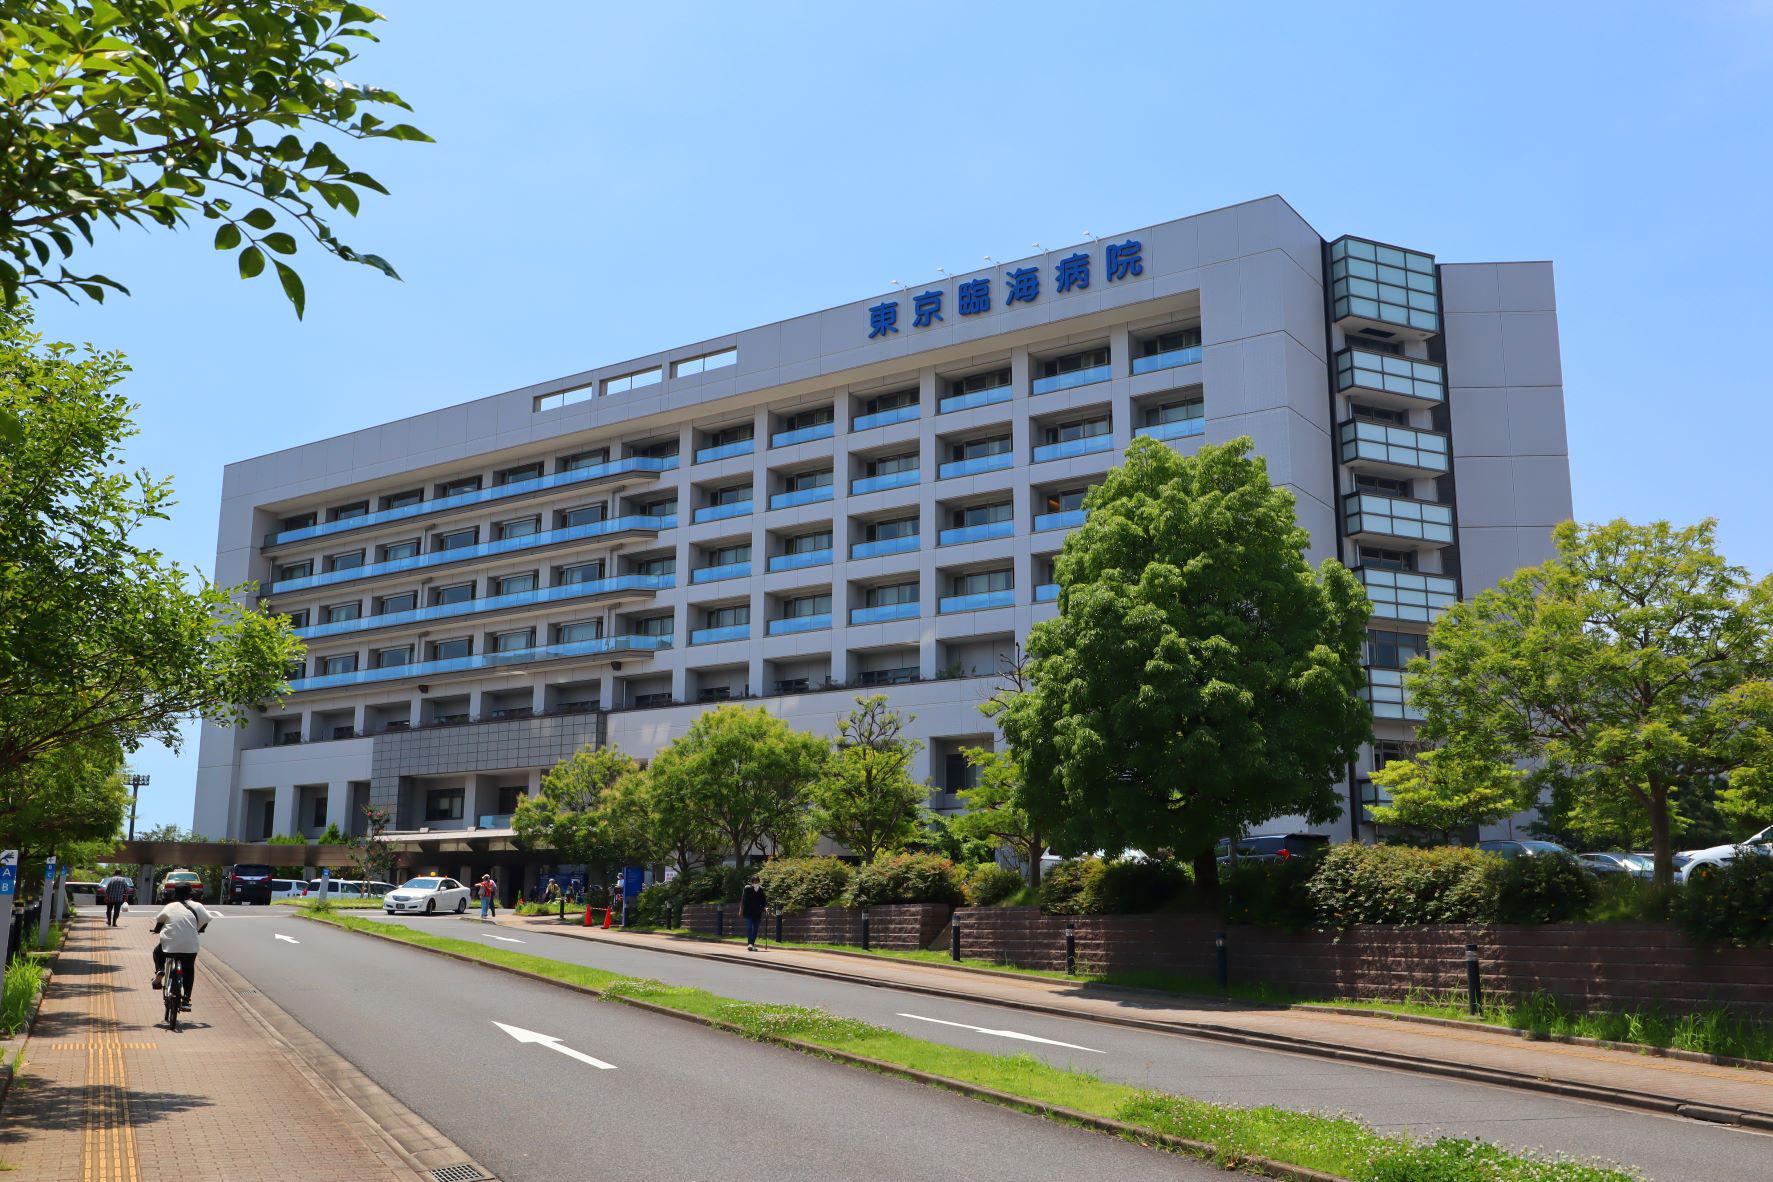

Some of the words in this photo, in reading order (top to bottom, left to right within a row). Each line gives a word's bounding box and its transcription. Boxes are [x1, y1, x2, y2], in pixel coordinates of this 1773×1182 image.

[868, 239, 1143, 338] 東京臨海病院
[2, 868, 11, 877] A
[1, 882, 9, 892] B
